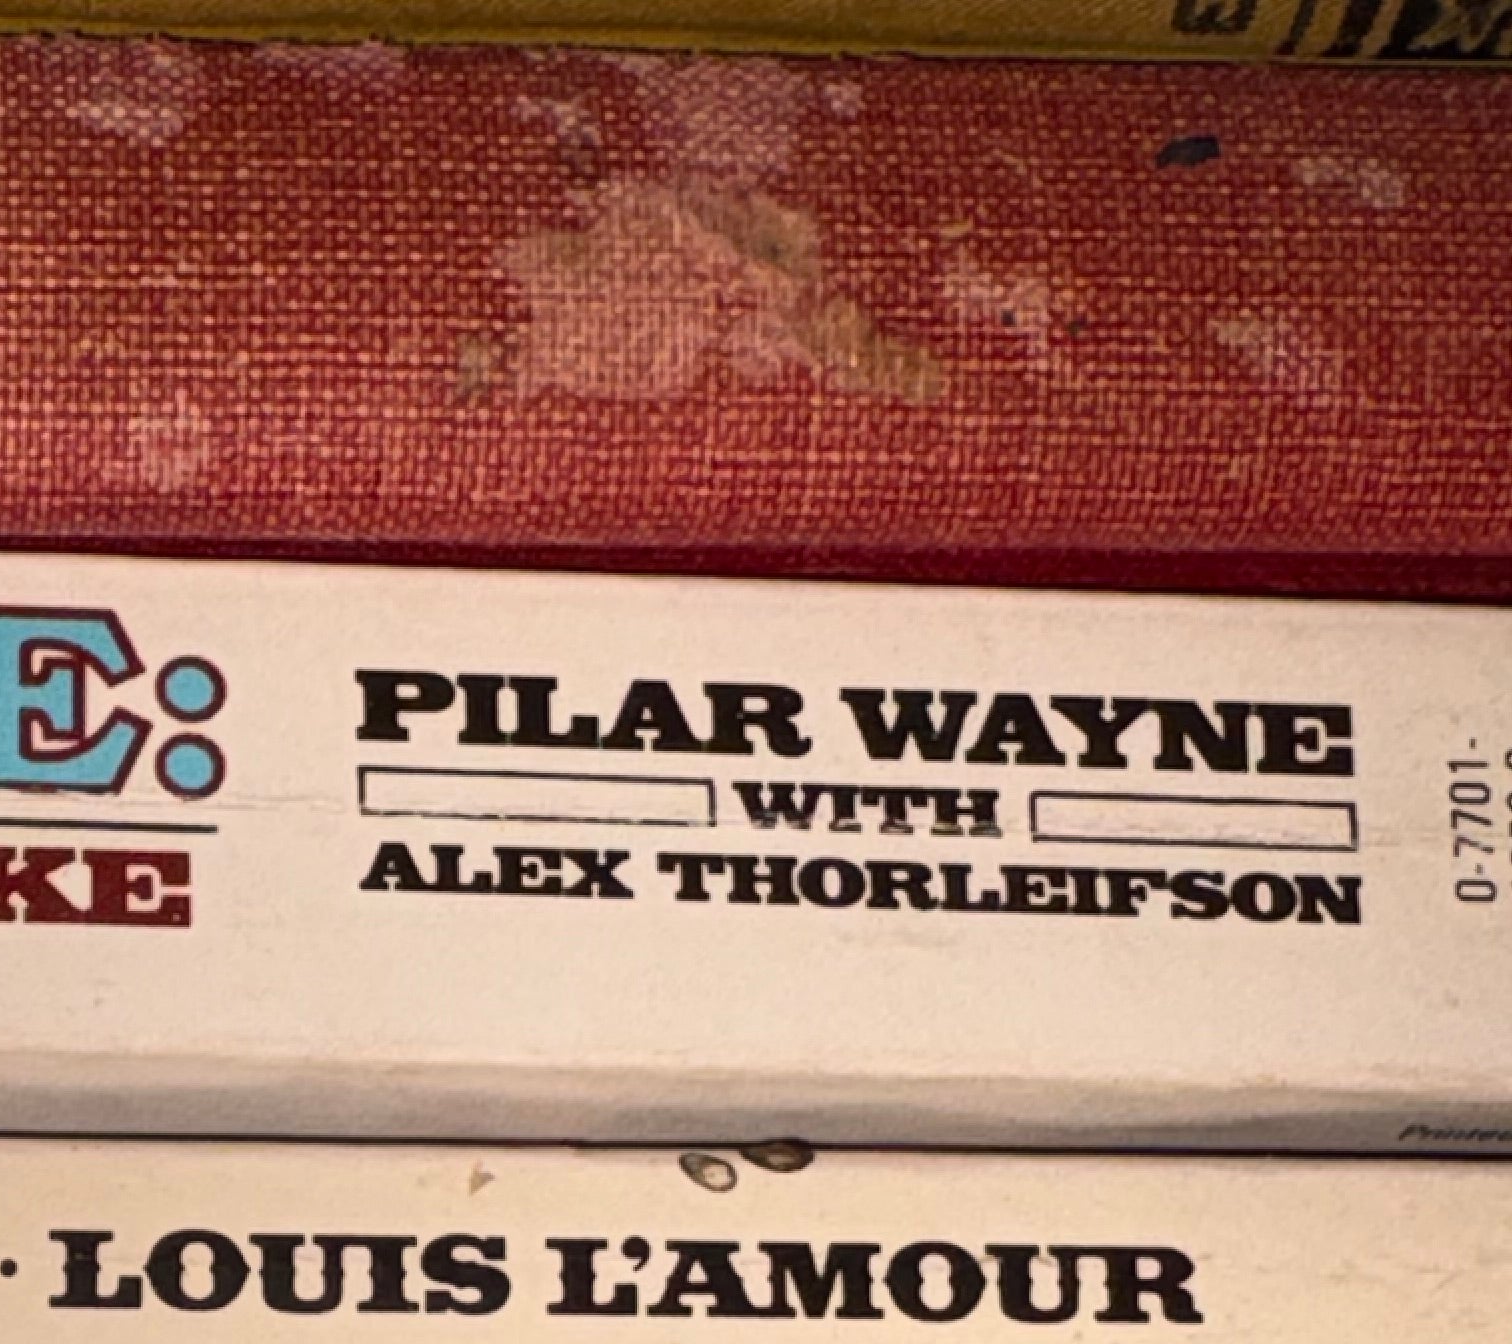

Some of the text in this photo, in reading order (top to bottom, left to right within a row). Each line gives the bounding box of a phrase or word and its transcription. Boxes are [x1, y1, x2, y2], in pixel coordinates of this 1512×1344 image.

[354, 668, 1354, 777] PILAR WAYNE
[732, 780, 1003, 838] WITH
[1447, 737, 1498, 903] 0-7701-
[358, 841, 1362, 926] ALEX THORLEIFSON
[48, 1228, 512, 1316] LOUIS
